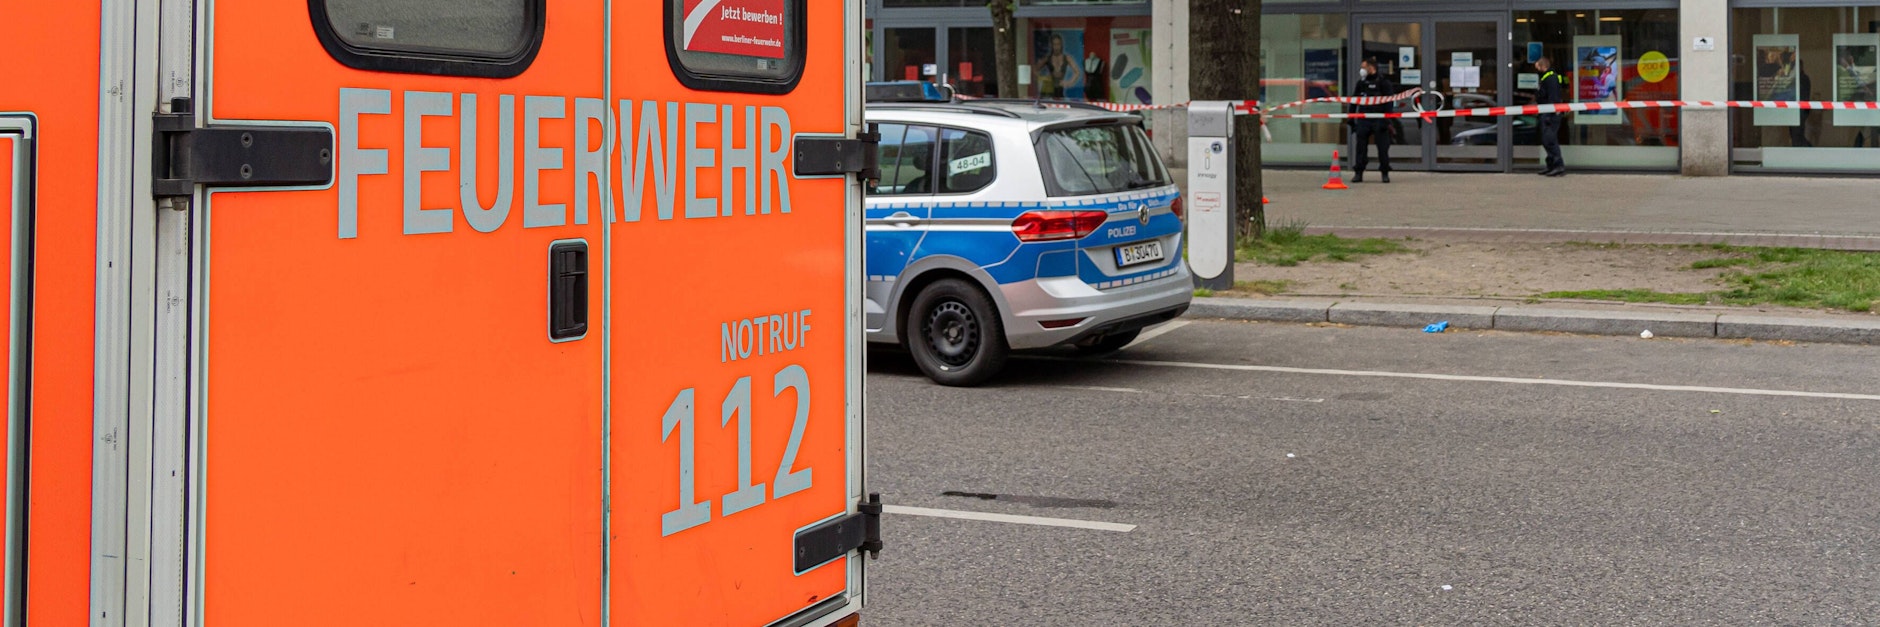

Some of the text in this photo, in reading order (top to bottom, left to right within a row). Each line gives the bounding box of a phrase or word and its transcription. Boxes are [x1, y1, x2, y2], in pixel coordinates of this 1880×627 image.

[721, 5, 741, 20] Jetzt
[742, 7, 778, 24] bewerben
[721, 34, 781, 47] www.berliner-feuerwehr.de
[338, 87, 792, 239] FEUERWEHR
[957, 155, 985, 169] 48-04
[1108, 225, 1136, 239] POLIZEI
[721, 308, 812, 363] NOTRUF
[661, 364, 813, 537] 112
